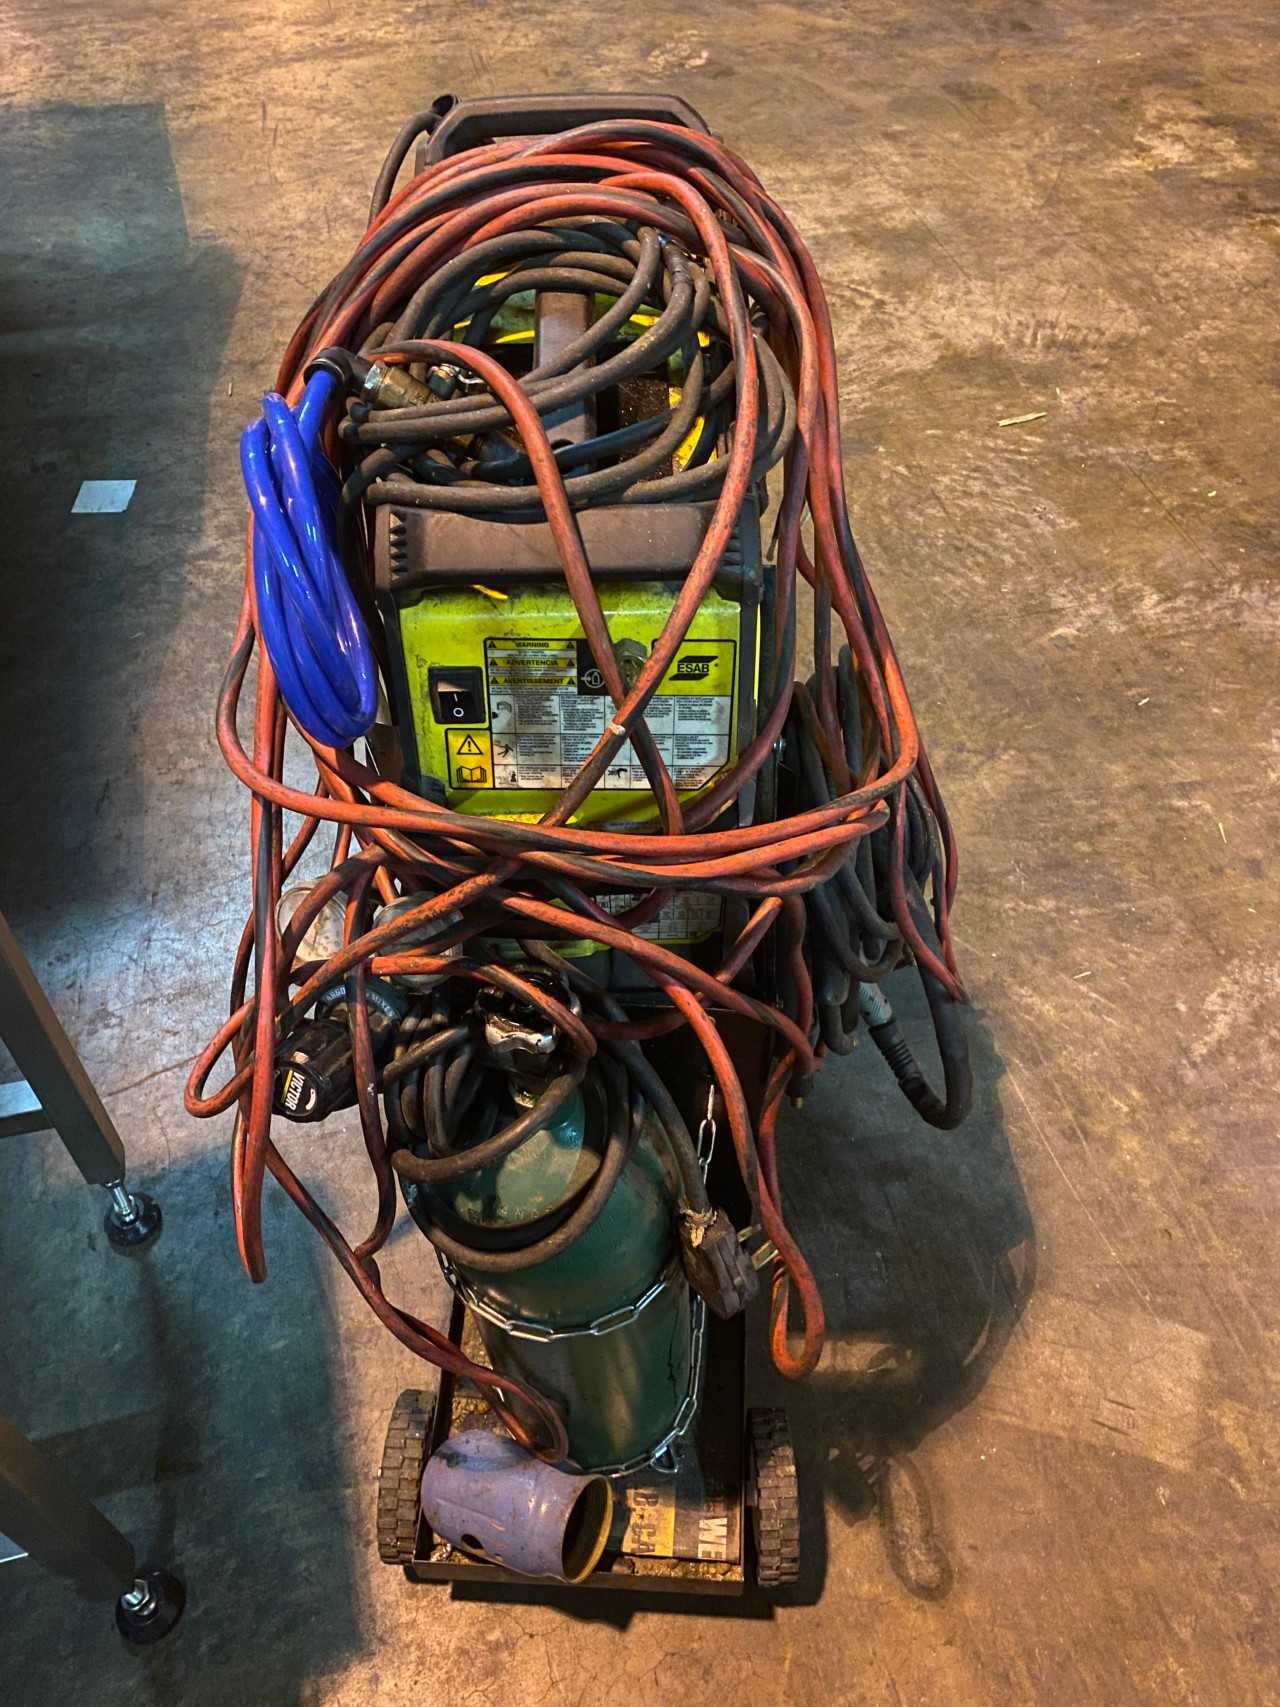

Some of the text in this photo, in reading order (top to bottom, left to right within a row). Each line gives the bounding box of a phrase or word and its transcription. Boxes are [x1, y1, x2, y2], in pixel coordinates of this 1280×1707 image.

[515, 641, 550, 649] WARNING
[677, 663, 710, 673] ESAB
[284, 1071, 305, 1111] VICTOR
